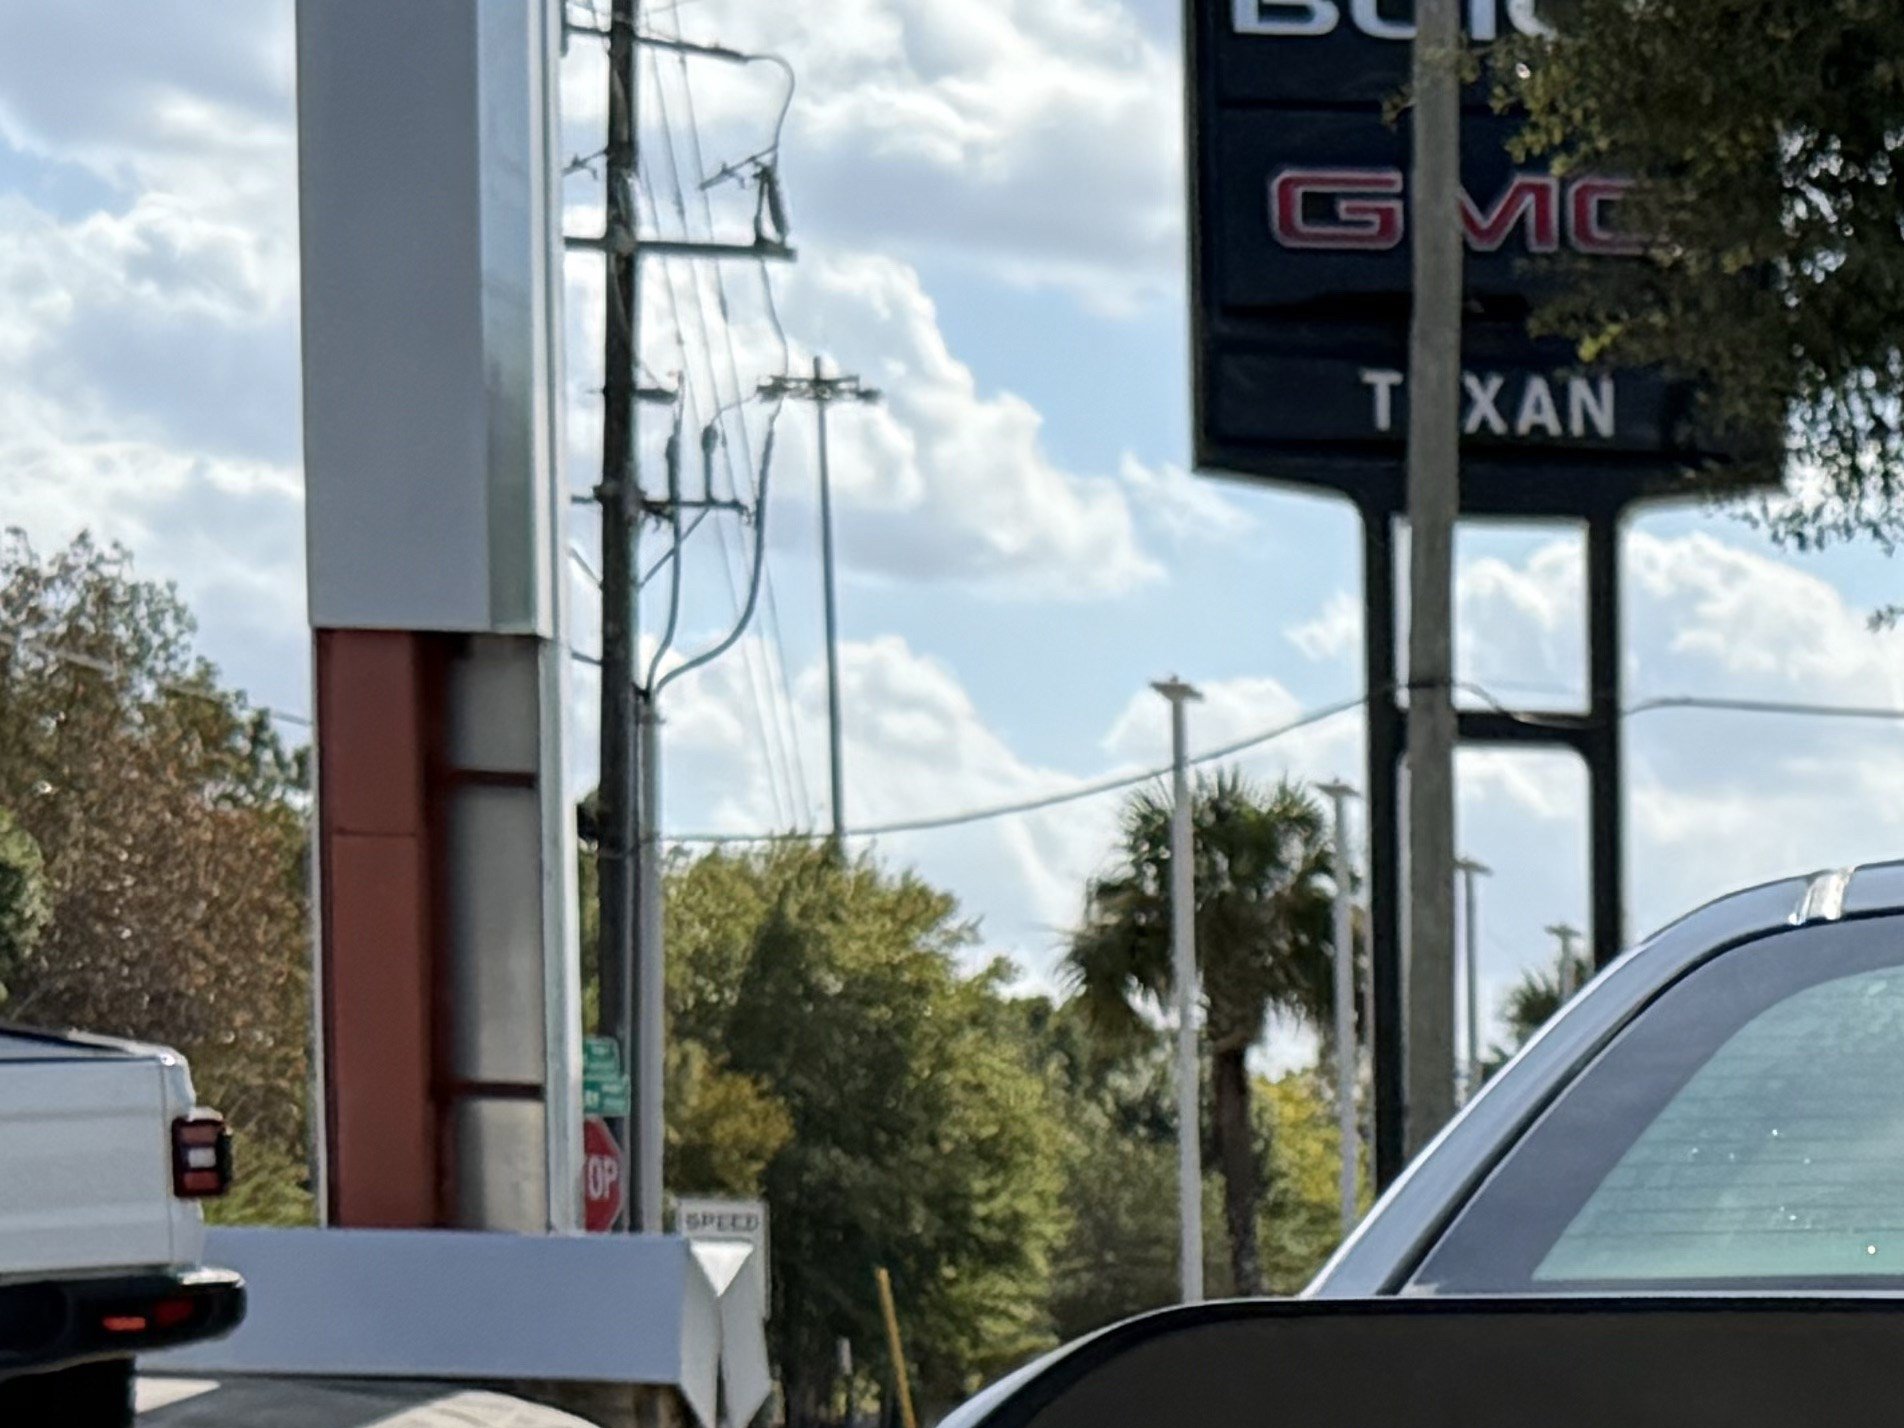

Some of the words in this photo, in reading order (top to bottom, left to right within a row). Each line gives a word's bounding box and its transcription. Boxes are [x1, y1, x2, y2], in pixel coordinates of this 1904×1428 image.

[1268, 168, 1645, 255] GMC
[1359, 368, 1616, 438] TXAN
[588, 1154, 619, 1200] OP
[685, 1212, 759, 1232] SPEED
